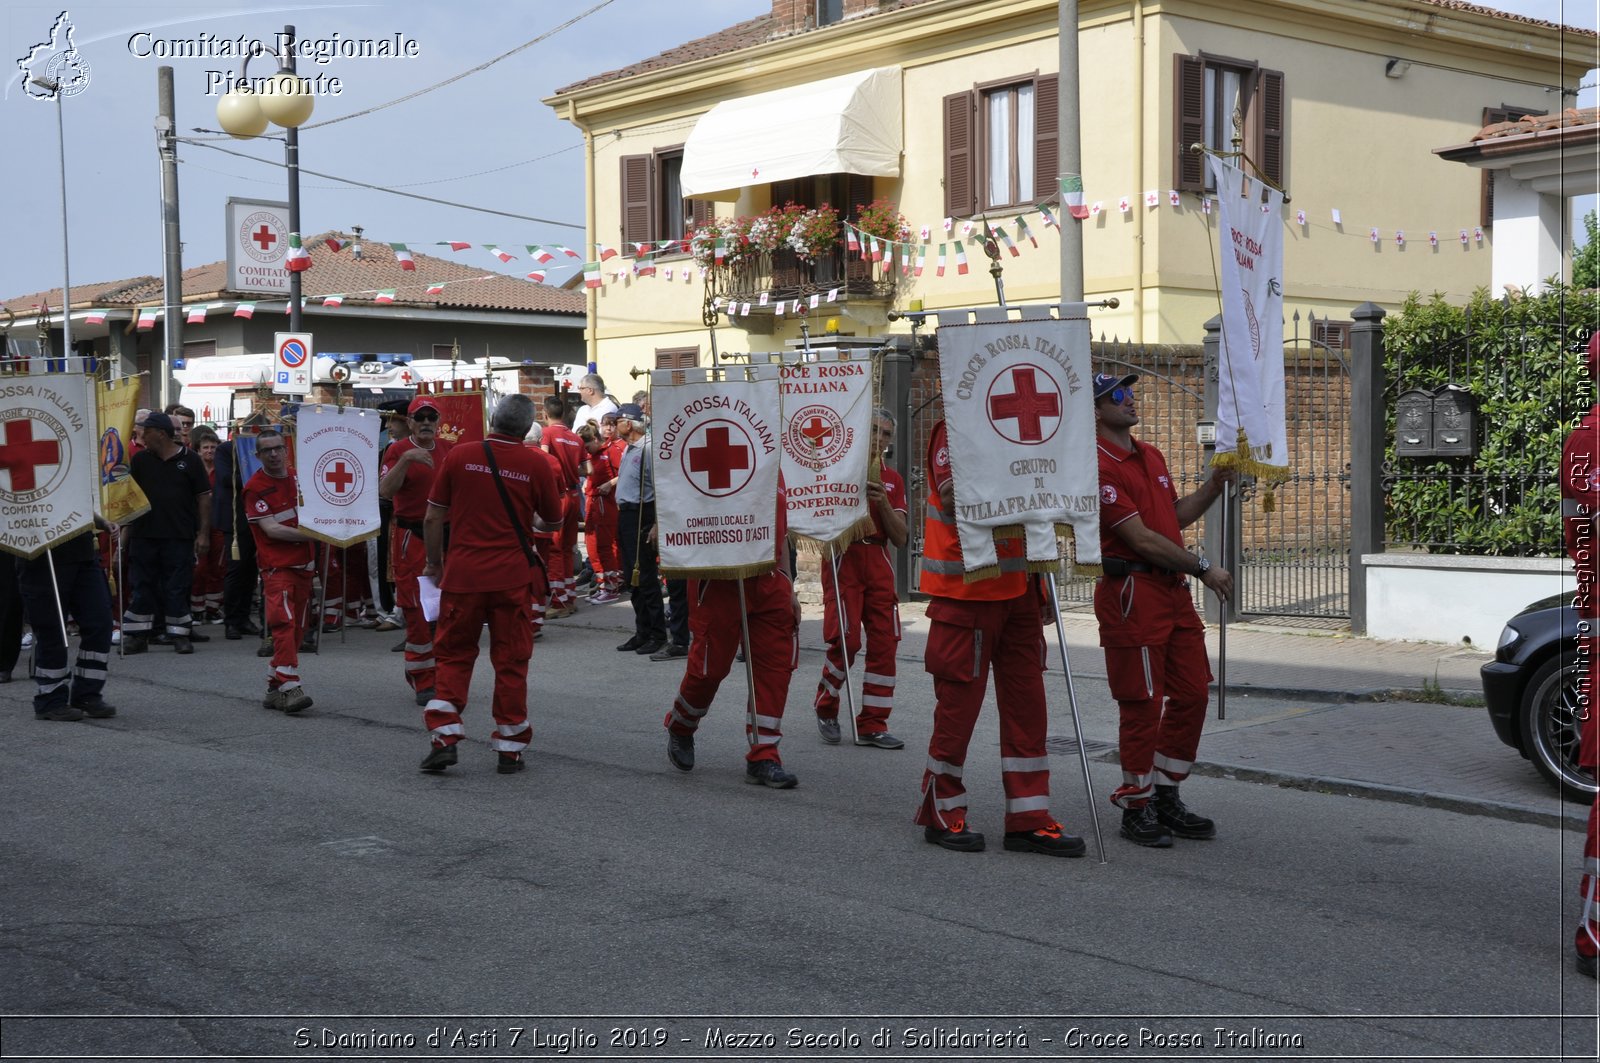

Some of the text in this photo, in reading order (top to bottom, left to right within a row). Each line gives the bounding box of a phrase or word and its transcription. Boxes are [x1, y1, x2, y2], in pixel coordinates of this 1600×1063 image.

[239, 266, 291, 278] COMITATO
[245, 277, 285, 287] LOCALE
[818, 364, 864, 378] ROSSA
[956, 334, 1082, 401] CROCE ROSSA ITALIANA
[779, 381, 848, 395] ITALIANA
[37, 386, 84, 433] ITALIANA
[659, 395, 776, 460] CROCE ROSSA ITALIANA
[303, 426, 334, 445] VOLONTARI
[347, 427, 374, 449] SOCCORSO
[781, 432, 812, 469] VOLONTARI
[831, 427, 854, 465] SOCCORSO
[1009, 458, 1057, 477] GRUPPO
[816, 474, 827, 482] DI
[1034, 477, 1044, 488] DI
[1, 503, 53, 516] COMITATO
[813, 509, 834, 518] ASTI
[959, 493, 1063, 521] VILLAFRANCA
[1061, 494, 1099, 513] D'ASTI
[8, 518, 49, 530] LOCALE
[44, 511, 82, 541] D'ASTI
[313, 517, 337, 525] Gruppo
[687, 516, 719, 528] COMITATO
[720, 515, 749, 526] LOCALE
[666, 526, 769, 546] MONTEGROSSO D'ASTI
